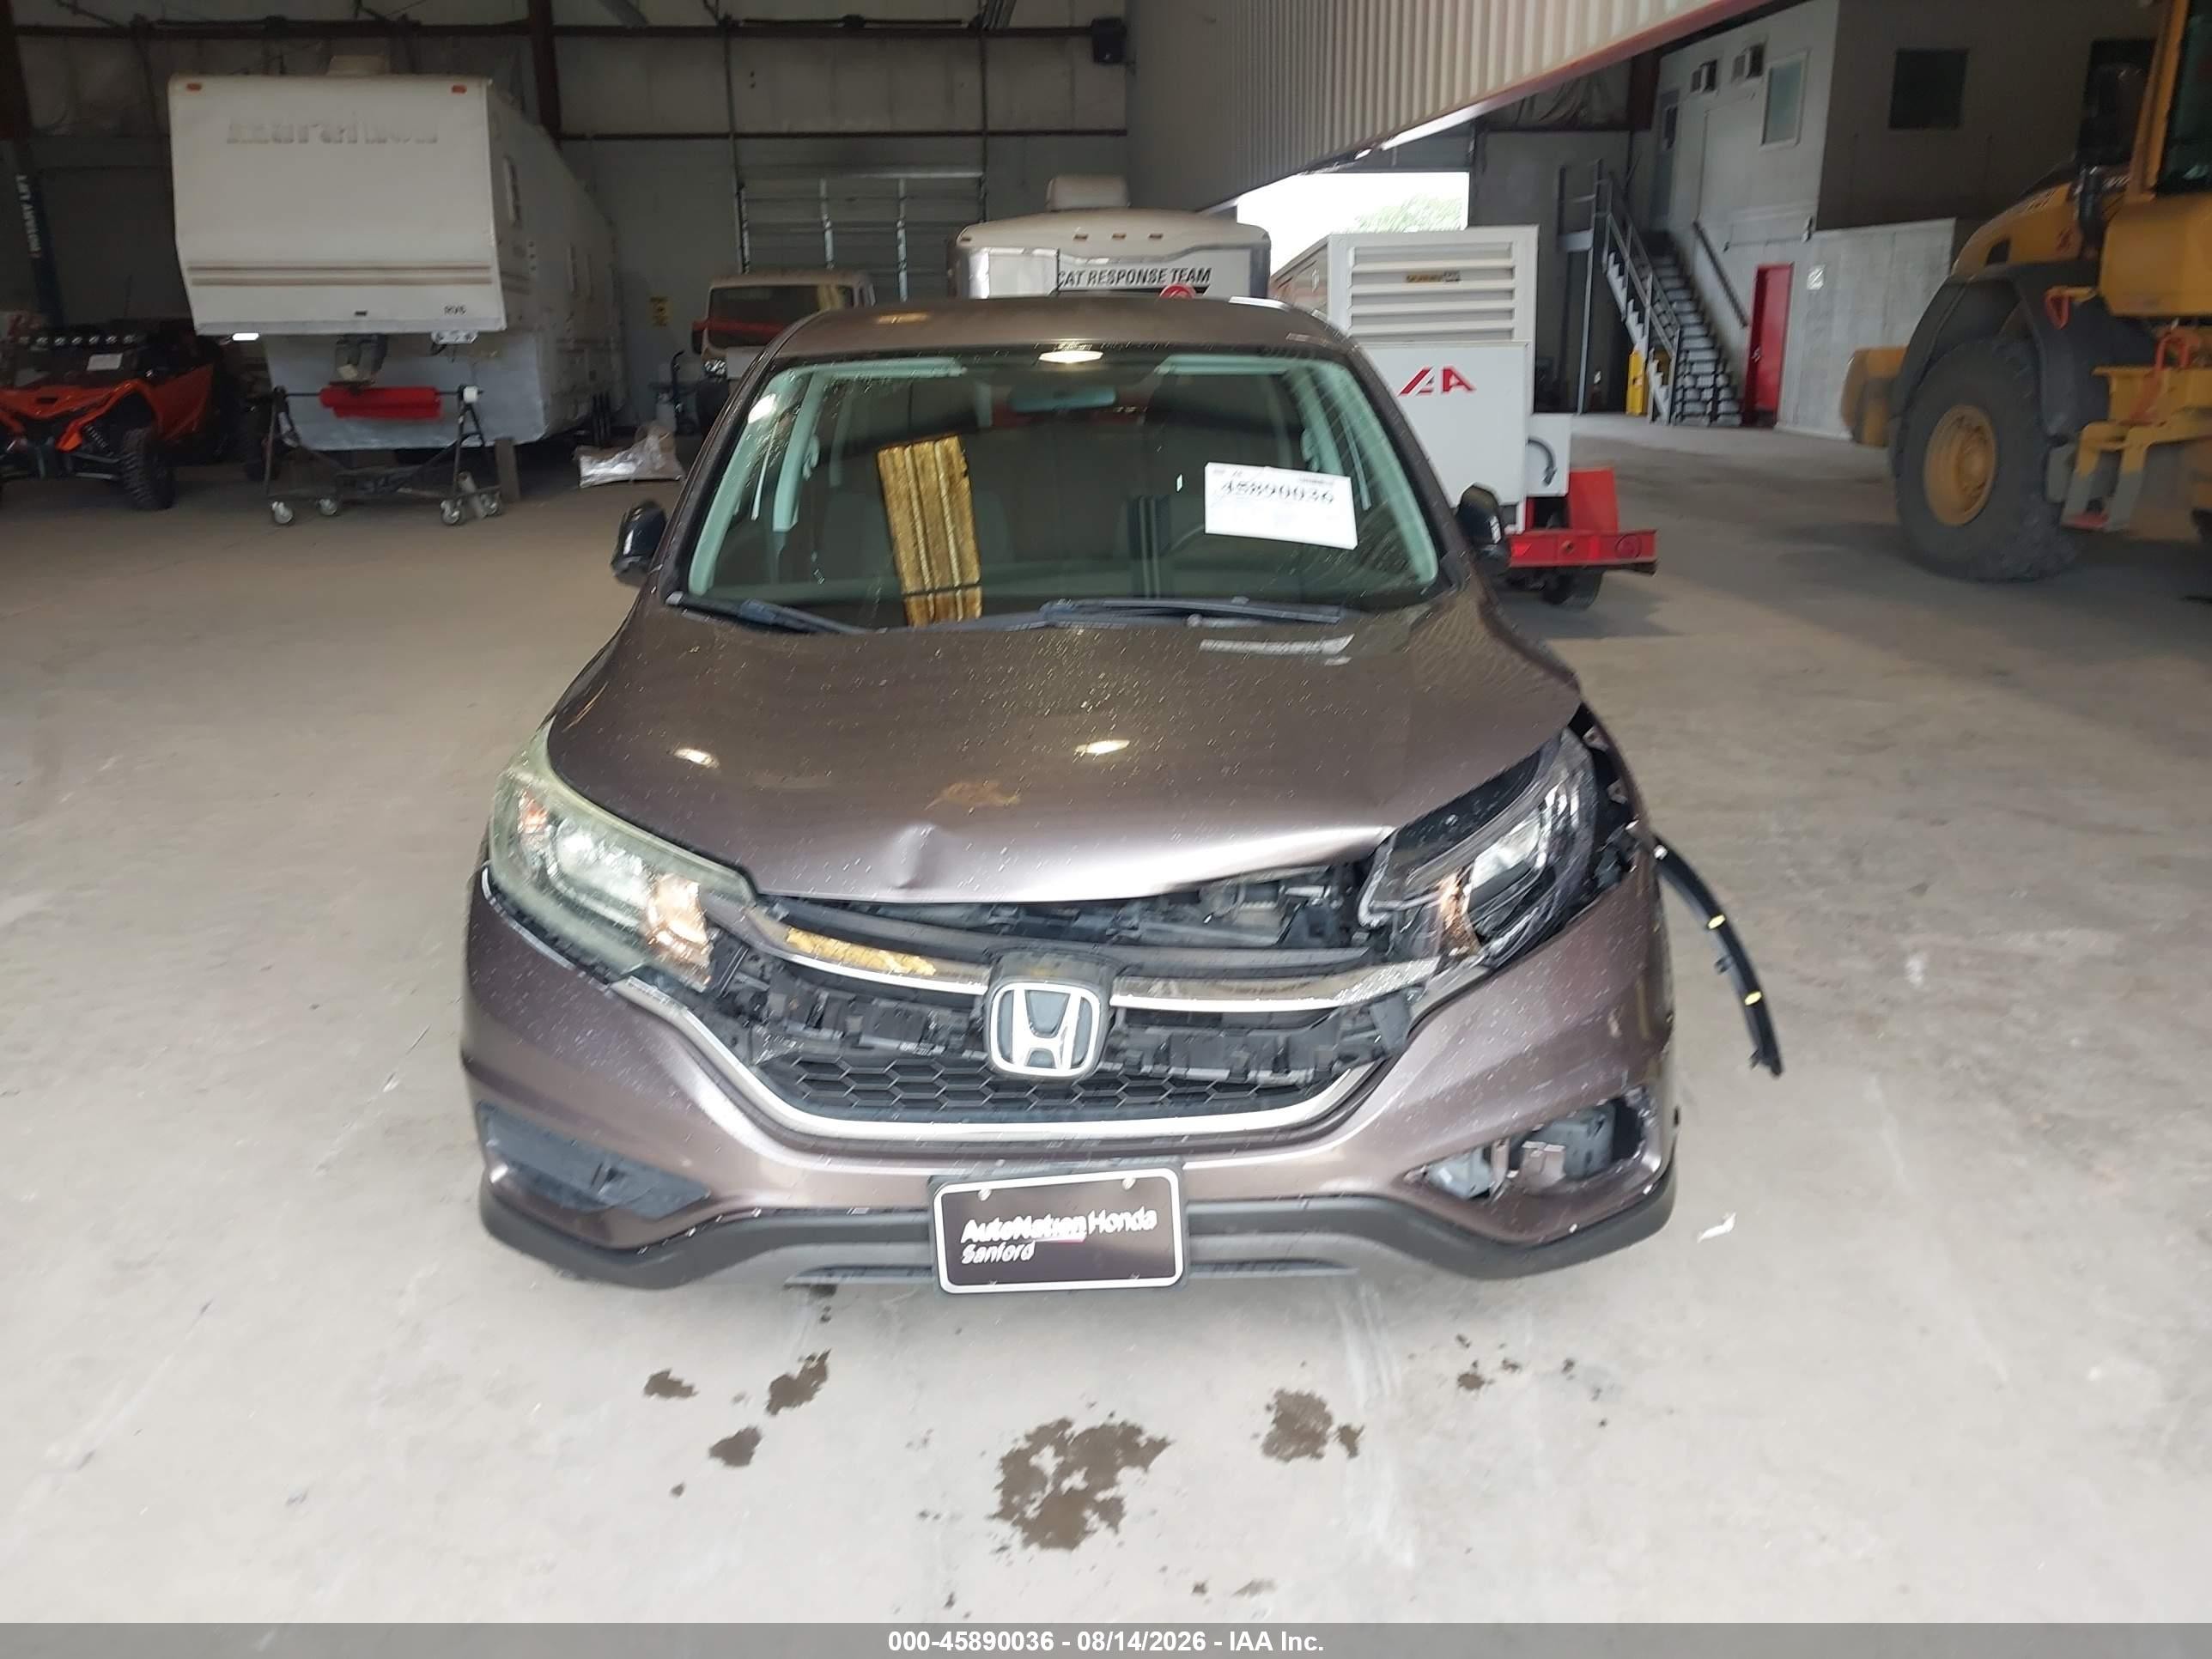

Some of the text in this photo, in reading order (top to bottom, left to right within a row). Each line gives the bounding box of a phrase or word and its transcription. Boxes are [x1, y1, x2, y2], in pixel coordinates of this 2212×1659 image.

[1087, 268, 1168, 285] RESPONSE
[1170, 267, 1212, 283] TEAM
[1088, 1206, 1158, 1235] Honda
[961, 1241, 1036, 1264] Sanford
